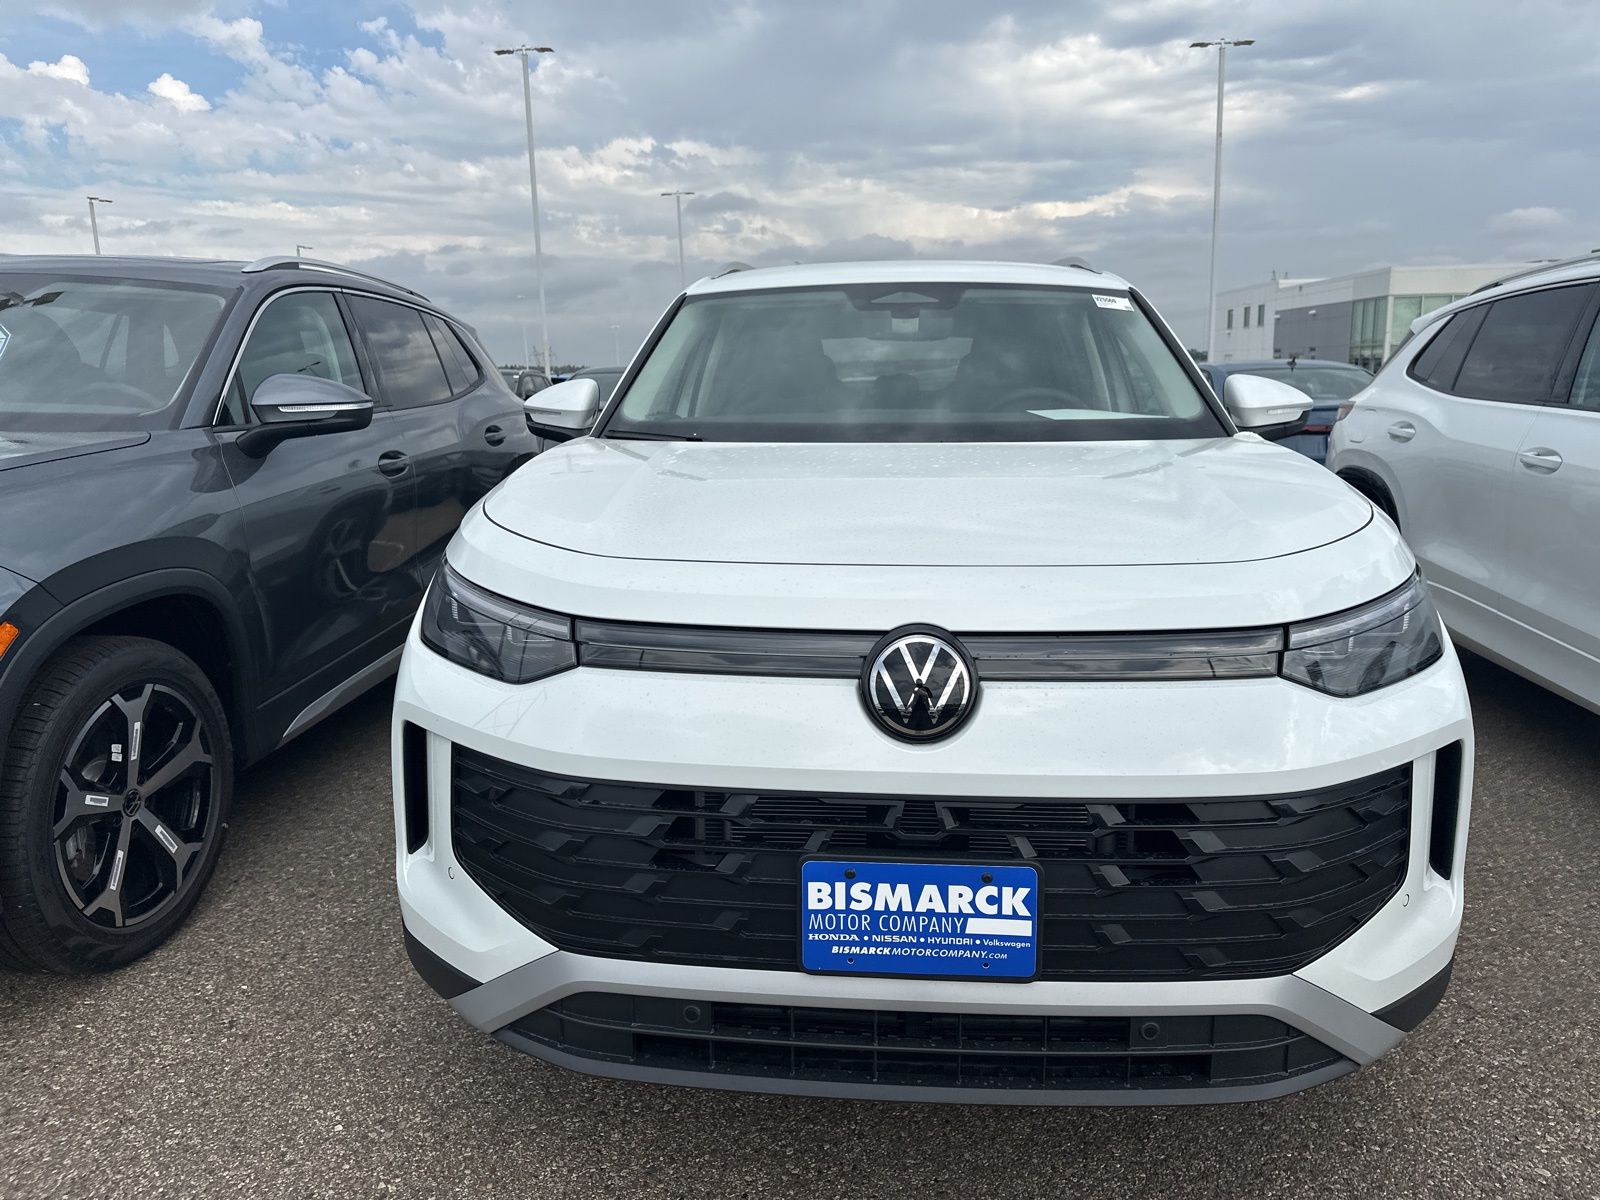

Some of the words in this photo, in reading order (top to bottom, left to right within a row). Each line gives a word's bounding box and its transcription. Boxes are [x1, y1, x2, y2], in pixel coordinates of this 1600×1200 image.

[807, 881, 1033, 917] BISMARCK
[808, 914, 871, 931] MOTOR
[879, 915, 964, 934] COMPANY
[808, 933, 860, 941] HONDA
[872, 935, 917, 943] NISSAN
[927, 937, 973, 945] HYUNDAI
[982, 938, 1031, 949] Volkswagen
